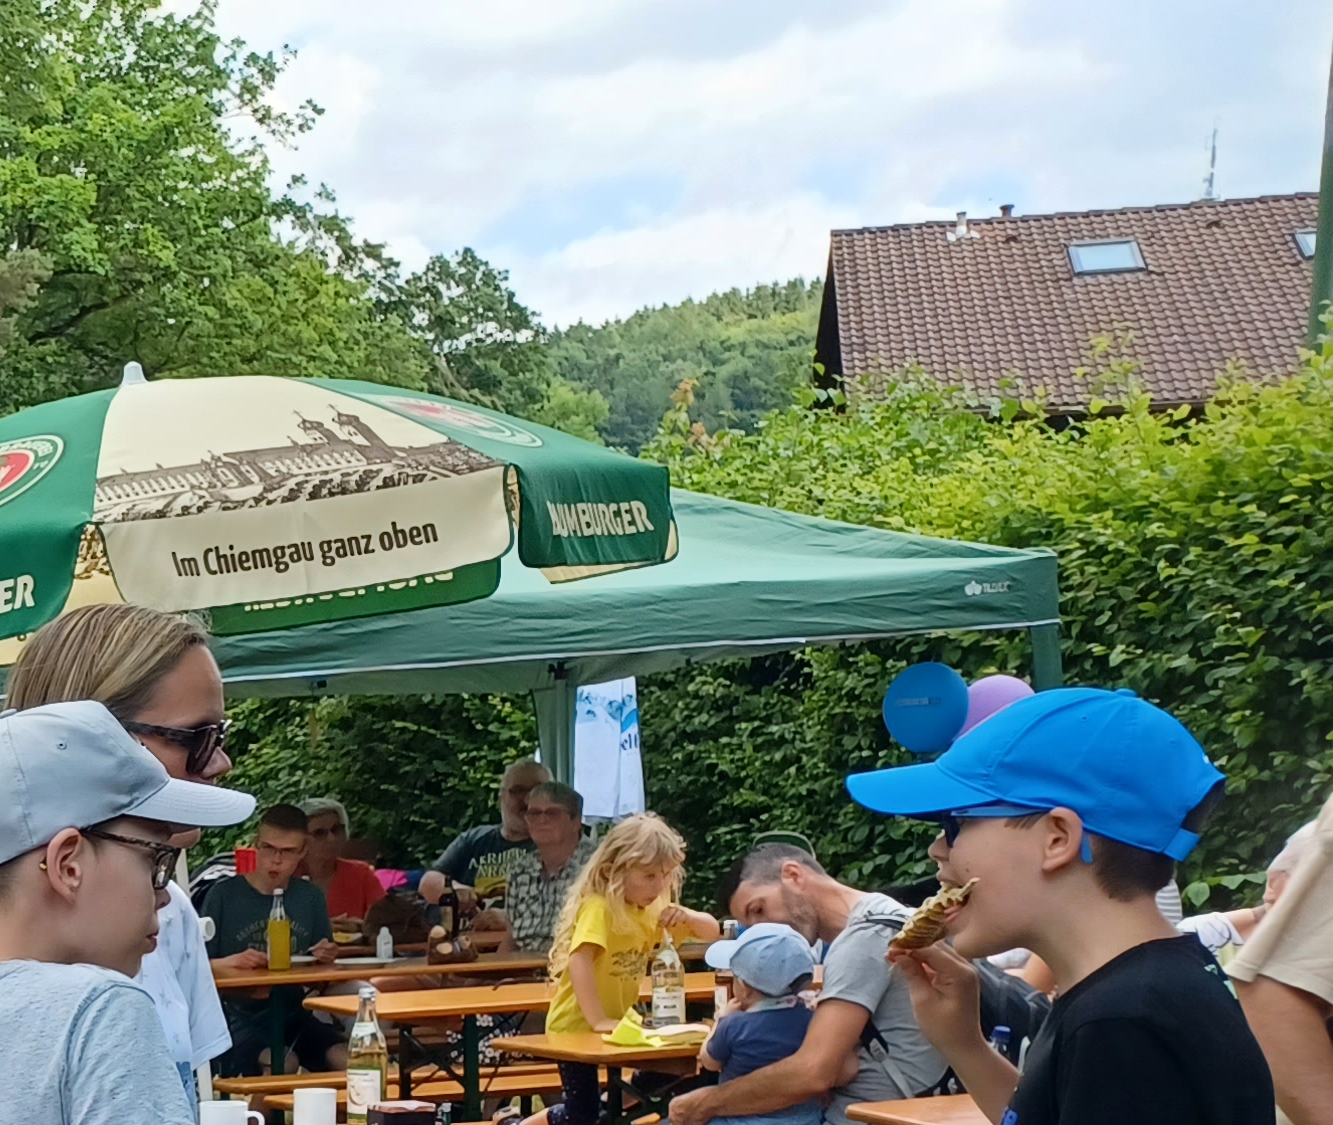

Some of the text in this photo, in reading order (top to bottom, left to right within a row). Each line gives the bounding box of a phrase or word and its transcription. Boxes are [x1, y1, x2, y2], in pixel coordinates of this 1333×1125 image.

[171, 521, 439, 577] Im Chiemgau ganz oben
